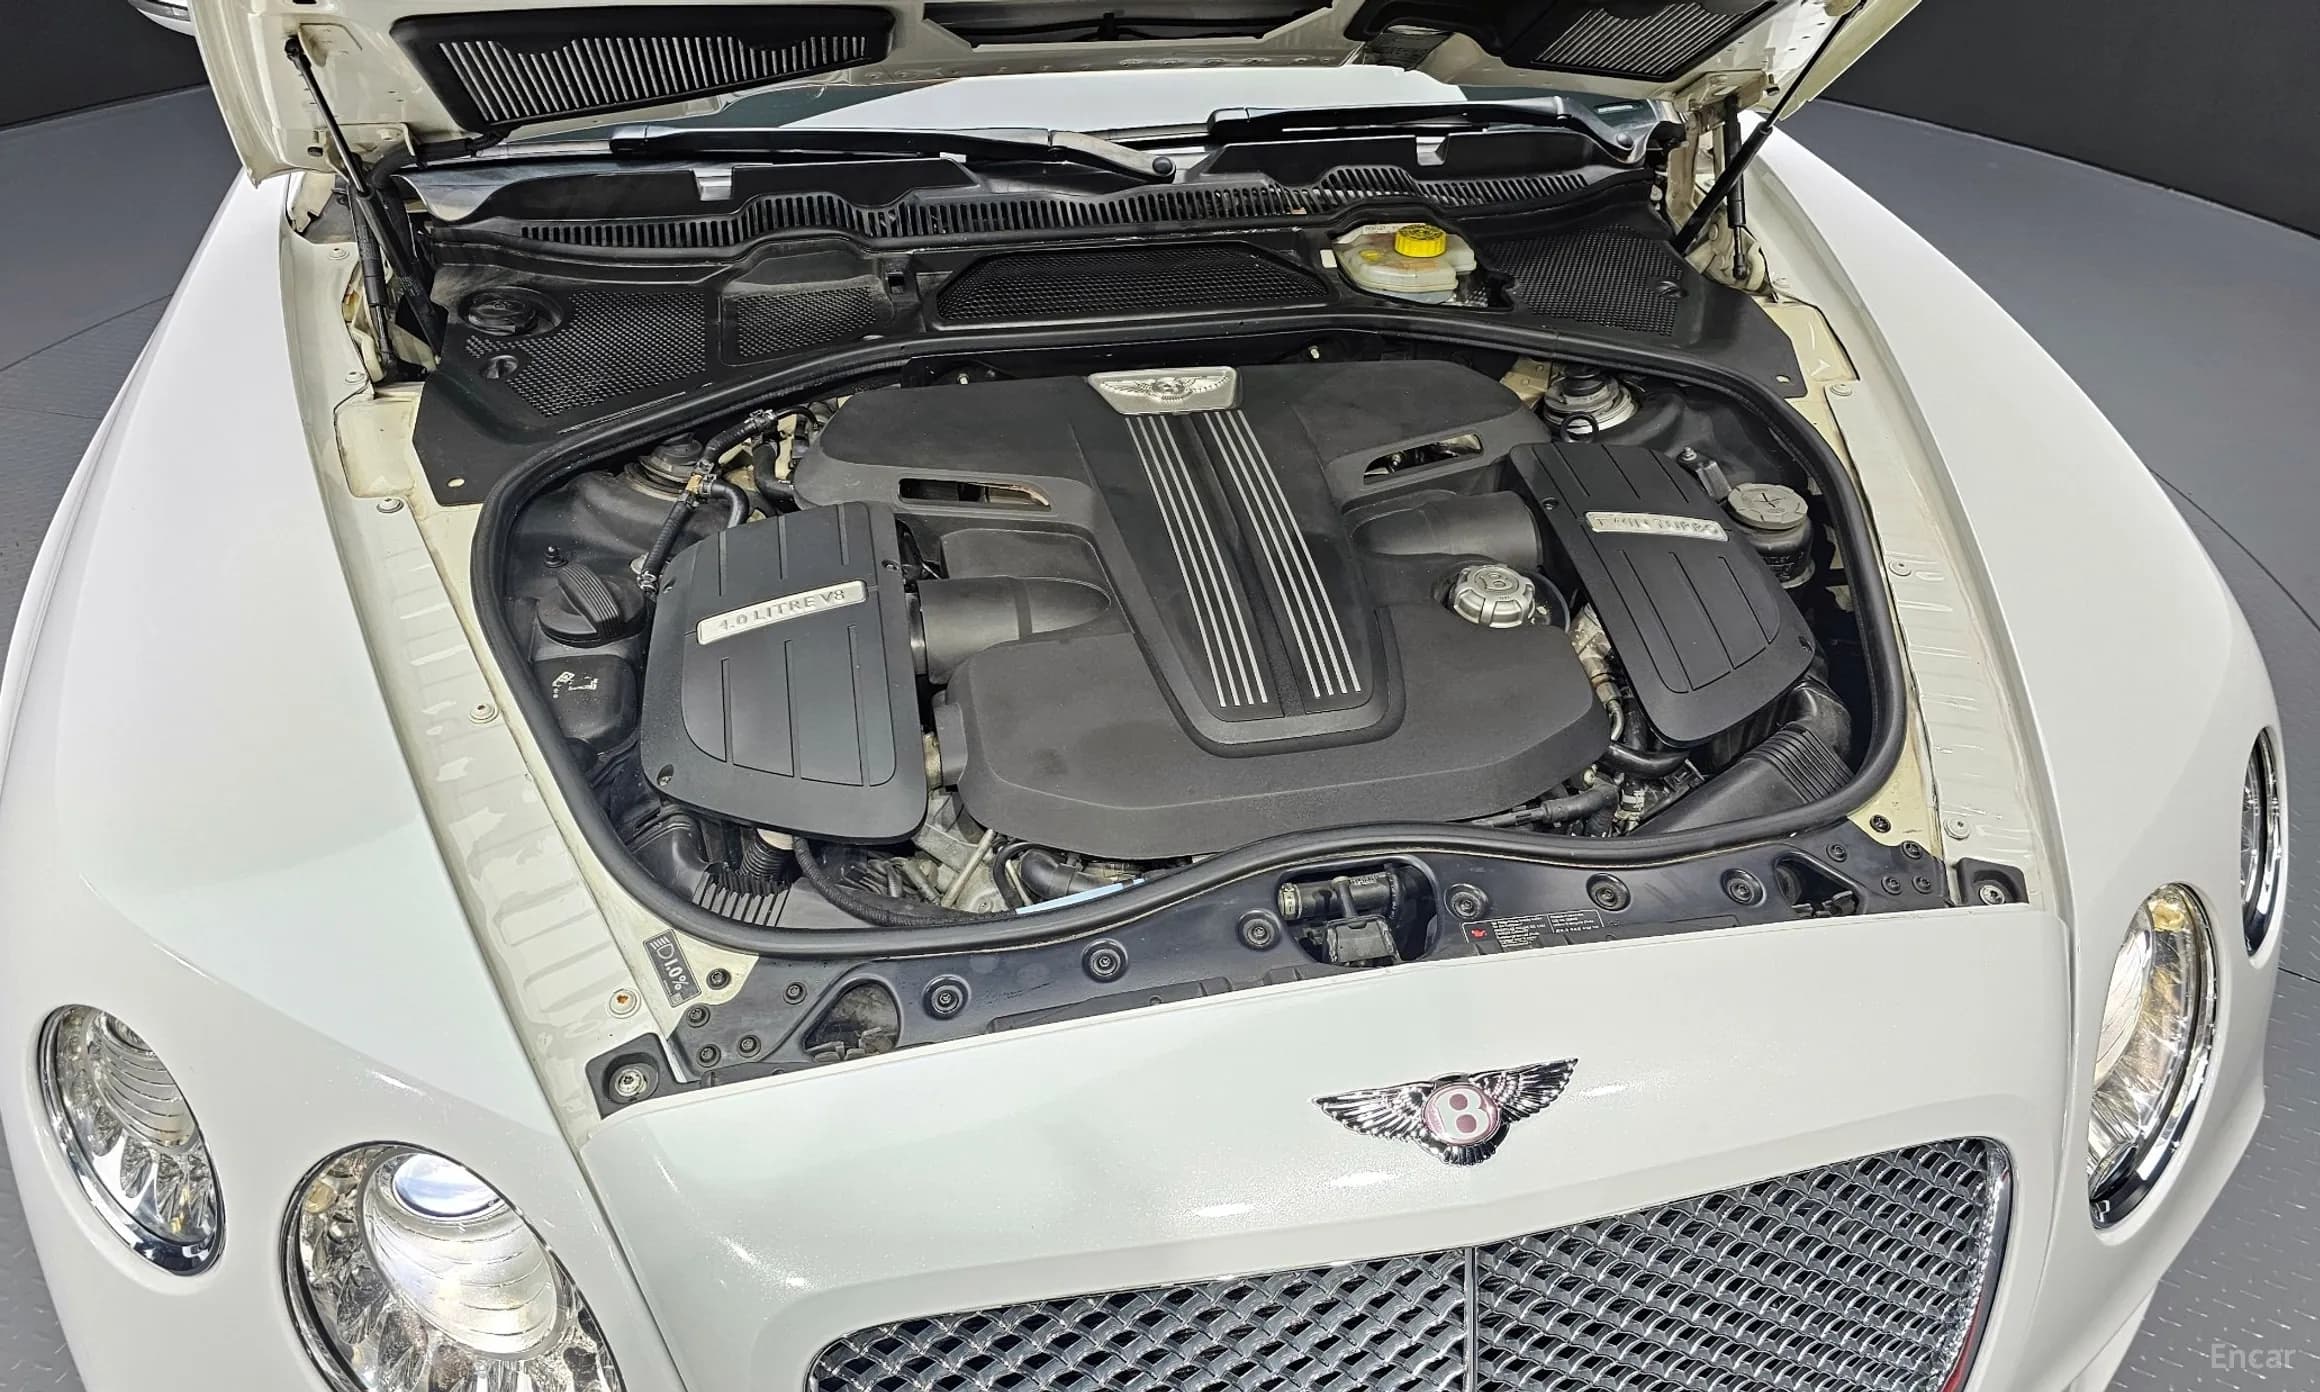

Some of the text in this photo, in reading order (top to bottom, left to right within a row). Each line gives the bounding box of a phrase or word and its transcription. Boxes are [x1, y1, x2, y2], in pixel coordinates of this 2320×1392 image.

[718, 589, 846, 632] 4.0 LITRE V8
[664, 958, 689, 991] 1.0%
